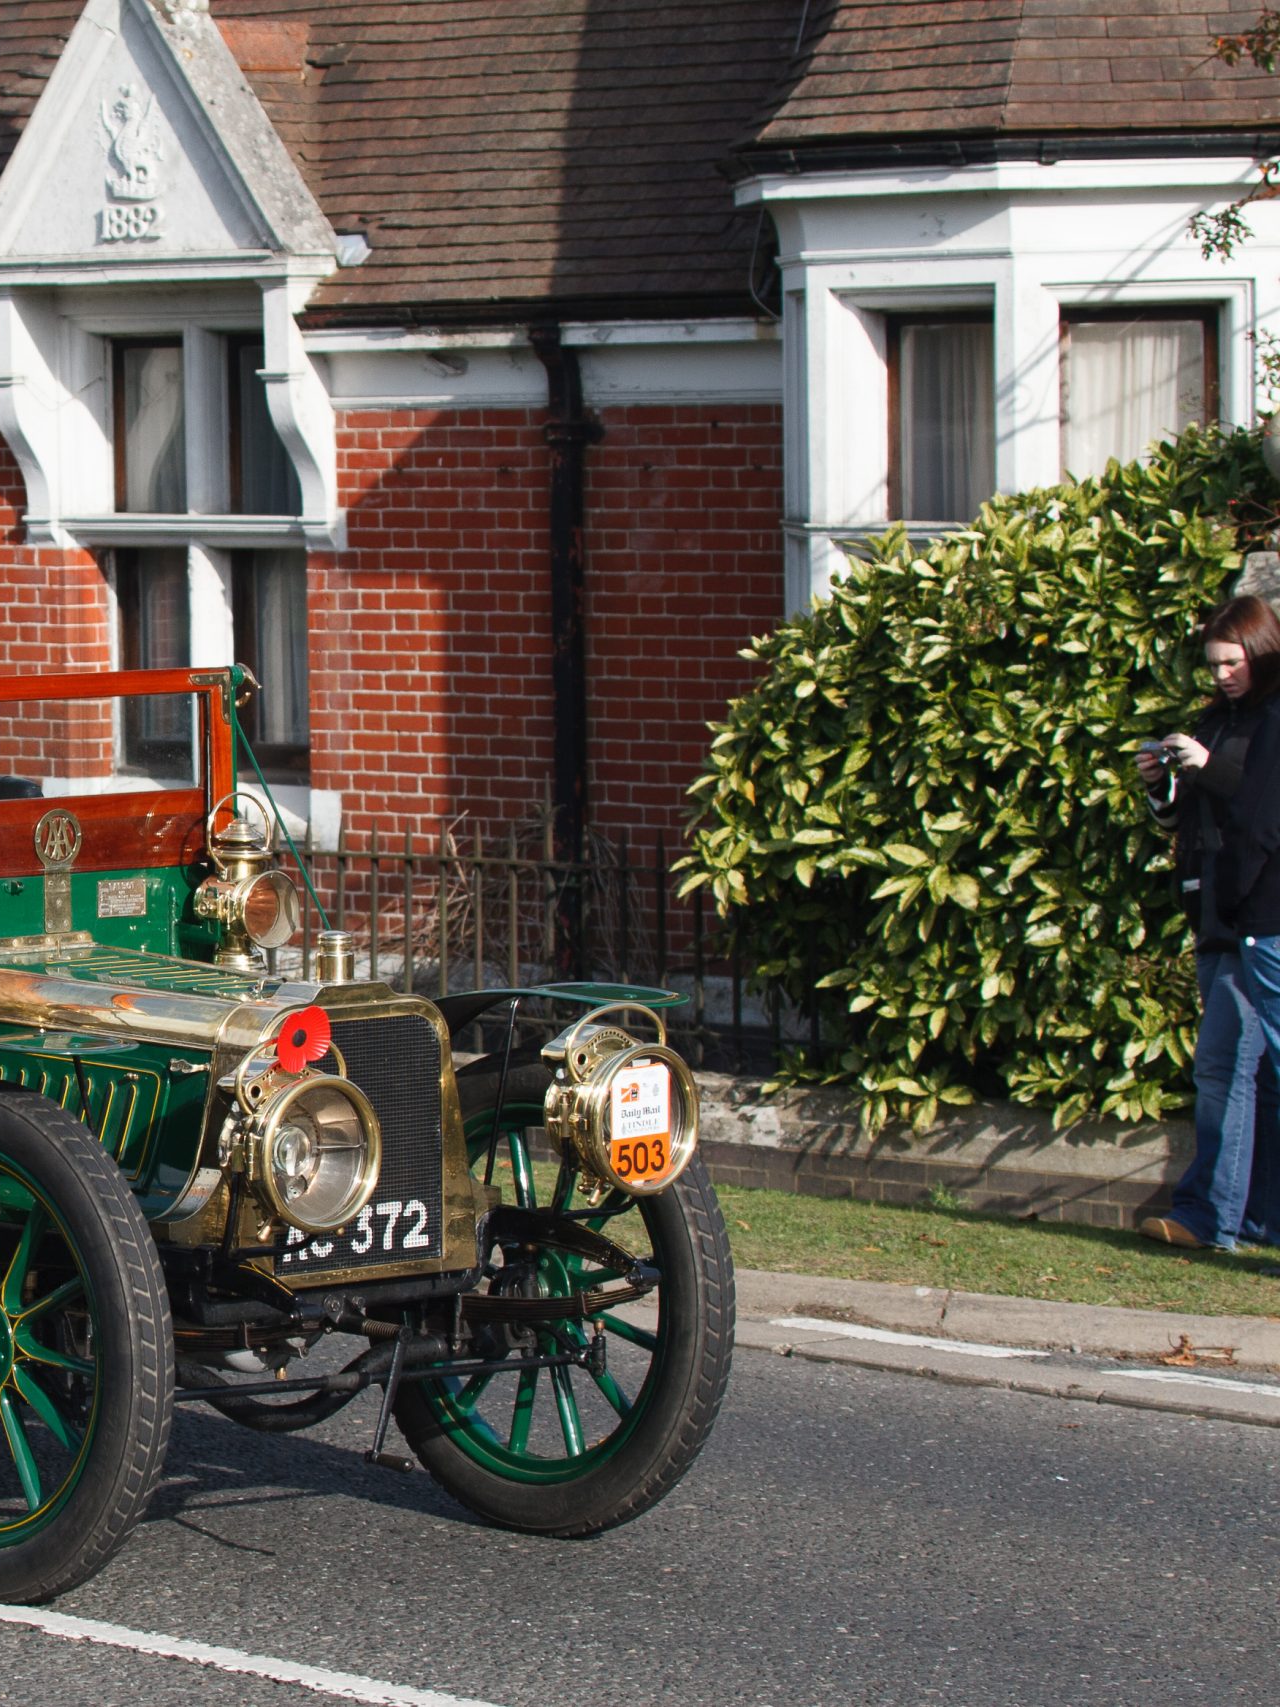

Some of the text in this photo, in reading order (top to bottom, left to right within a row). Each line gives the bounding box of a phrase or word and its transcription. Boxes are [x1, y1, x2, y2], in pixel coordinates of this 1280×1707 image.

[100, 206, 166, 239] 1882
[621, 1105, 660, 1119] Daily Mail
[617, 1139, 665, 1177] 503
[351, 1200, 429, 1253] 372
